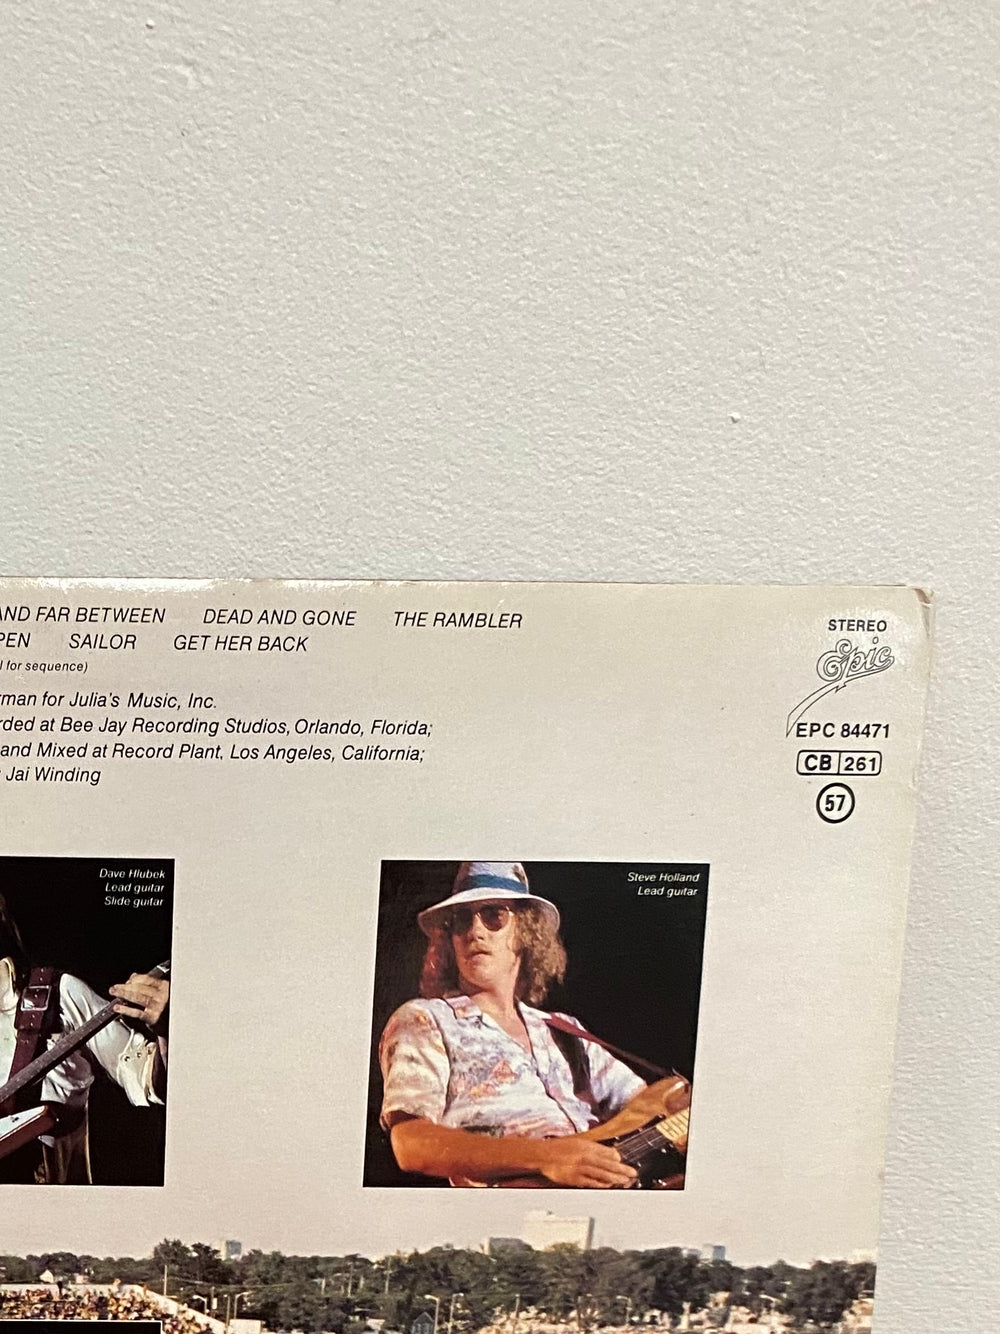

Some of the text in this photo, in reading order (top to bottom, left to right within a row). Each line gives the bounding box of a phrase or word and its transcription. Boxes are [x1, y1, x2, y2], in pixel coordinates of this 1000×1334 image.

[35, 606, 71, 623] FAR
[75, 606, 166, 624] BETWEEN
[202, 608, 254, 625] DEAD
[256, 609, 297, 625] AND
[302, 609, 357, 626] GONE
[394, 611, 429, 628] THE
[432, 611, 523, 629] RAMBLER
[828, 619, 887, 632] STEREO
[68, 633, 137, 650] SAILOR
[173, 634, 212, 651] GET
[214, 635, 253, 652] HER
[257, 635, 309, 652] BACK
[6, 659, 23, 671] for
[24, 661, 88, 674] sequence)
[41, 690, 66, 707] for
[68, 691, 121, 708] Julia's
[127, 692, 181, 711] Music,
[187, 692, 217, 709] Inc.
[39, 717, 56, 732] at
[59, 716, 94, 733] Bee
[98, 716, 128, 737] Jay
[131, 717, 220, 738] Recording
[224, 717, 290, 737] Studios,
[294, 718, 364, 737] Orlando,
[370, 719, 433, 738] Florida;
[796, 722, 890, 739] EPC 84471
[0, 741, 33, 758] and
[36, 742, 89, 758] Mixed
[91, 744, 108, 759] at
[111, 742, 175, 759] Record
[178, 743, 223, 761] Plant,
[230, 743, 260, 760] Los
[263, 744, 335, 764] Angeles,
[341, 744, 425, 763] California;
[804, 754, 877, 771] CB 261
[5, 766, 31, 782] Jai
[35, 766, 102, 787] Winding
[824, 795, 846, 812] 57
[99, 868, 126, 879] Dave
[627, 871, 700, 882] Steve Holland
[105, 882, 165, 895] Lead guitar
[637, 886, 698, 898] Lead guitar
[104, 895, 164, 908] Slide guitar
